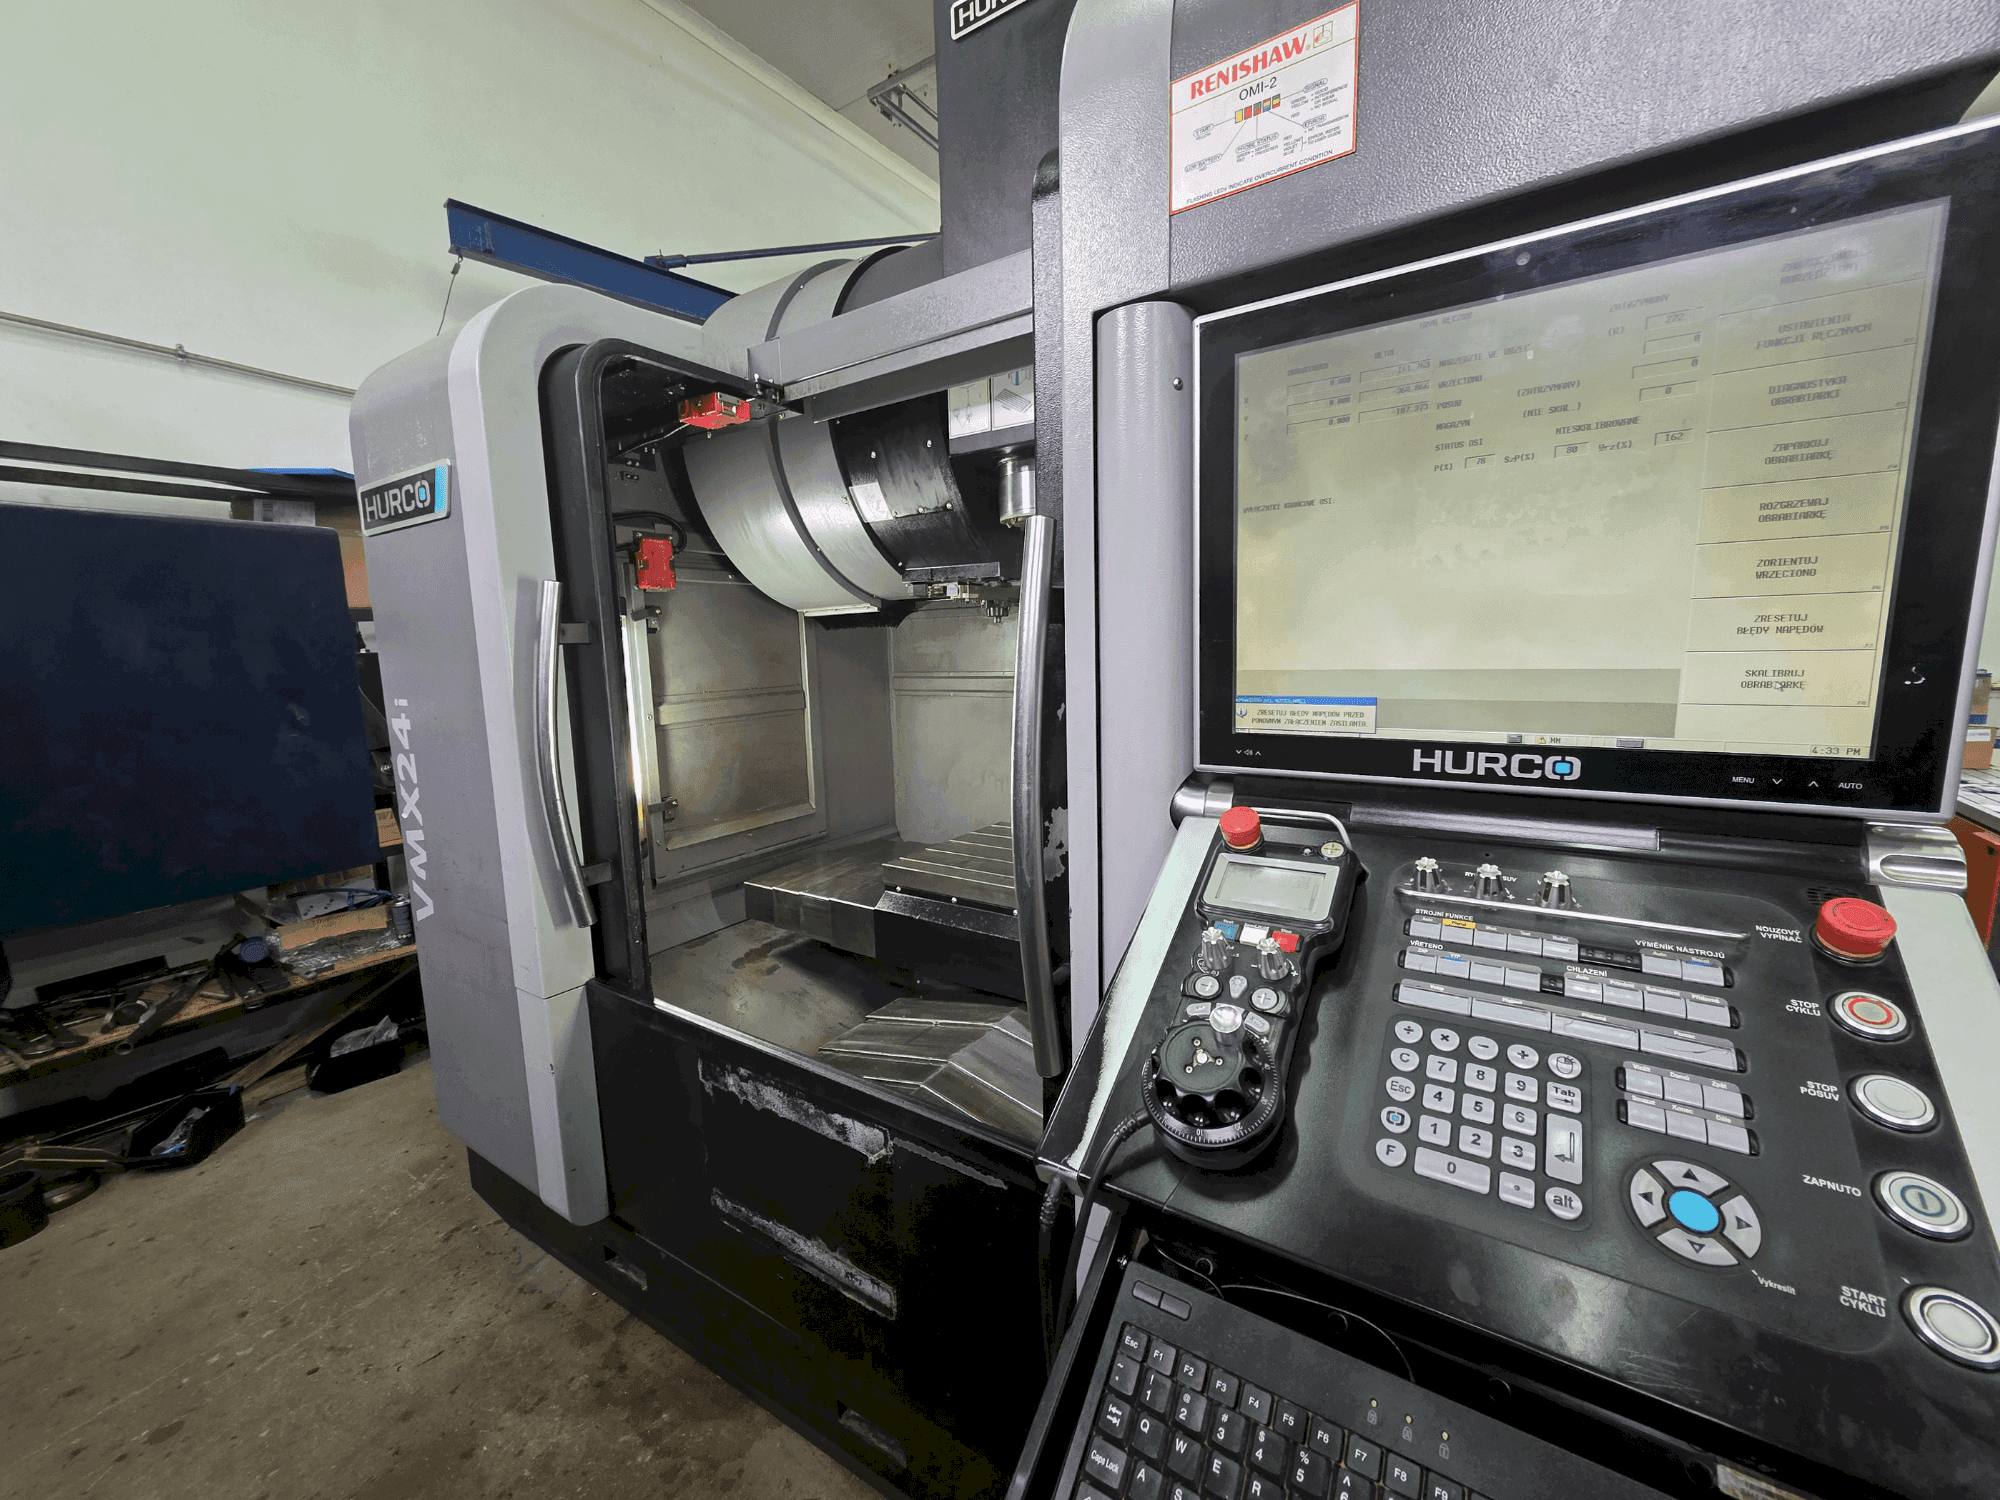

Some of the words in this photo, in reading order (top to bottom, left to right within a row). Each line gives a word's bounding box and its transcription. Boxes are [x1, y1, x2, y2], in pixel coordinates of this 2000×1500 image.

[1191, 33, 1307, 100] RENISHAW
[1239, 77, 1277, 101] OMI-2
[1187, 192, 1212, 204] FLASHING
[1228, 177, 1253, 189] INDICATE
[1299, 149, 1333, 165] CONDITION
[1665, 313, 1685, 324] 222
[1756, 333, 1805, 349] FUNKCJI
[1768, 376, 1847, 395] DIAGNOSTYKA
[1770, 388, 1841, 407] OBRABIARKI
[1436, 418, 1471, 431] MAGAZYN
[1665, 432, 1684, 442] 162
[1435, 440, 1465, 451] STATUS
[1468, 438, 1483, 447] OSI
[1772, 438, 1829, 452] ZAPARKUJ
[1764, 450, 1834, 465] OBRABIARKĘ
[1434, 462, 1453, 472] P(%)
[365, 479, 431, 522] HURCO
[1319, 497, 1336, 506] OSI:
[1759, 497, 1829, 511] ROZGRZEWAJ
[1758, 509, 1827, 523] OBRABIARKĘ
[1756, 556, 1819, 568] ZORIENTUJ
[1756, 568, 1817, 580] WRZECIONO
[1754, 613, 1808, 623] ZRESETUJ
[1736, 626, 1770, 636] BŁĘDY
[1775, 623, 1824, 635] NAPĘDÓW
[1745, 669, 1805, 678] SKALIBRUJ
[1256, 709, 1287, 717] ZRESETUJ
[1343, 711, 1365, 719] PRZED
[1812, 746, 1840, 755] 4:33
[1846, 747, 1862, 756] PM
[1412, 748, 1582, 781] HURCO
[1732, 776, 1755, 784] MENU
[1838, 782, 1863, 790] AUTO
[391, 698, 434, 921] VMX24i
[1415, 908, 1444, 917] STROJNÍ
[1445, 912, 1474, 922] FUNKCE
[1755, 924, 1801, 936] NOUZOVÝ
[1760, 931, 1803, 943] VYPÍNAČ
[1410, 939, 1444, 950] VŘETENO
[1634, 939, 1675, 951] VÝMĚNÍK
[1676, 944, 1726, 959] NÁSTROJŮ
[1566, 964, 1608, 978] CHLAZENÍ
[1575, 973, 1590, 981] Auto
[1785, 1004, 1821, 1017] CYKLU
[1790, 999, 1819, 1009] STOP
[1400, 1052, 1411, 1063] C
[1437, 1061, 1447, 1072] 7
[1475, 1069, 1486, 1081] 8
[1390, 1080, 1411, 1095] Esc
[1516, 1080, 1527, 1092] 9
[1552, 1086, 1576, 1098] Tab
[1806, 1080, 1838, 1093] STOP
[1433, 1091, 1444, 1102] 4
[1799, 1086, 1840, 1102] POSUV
[1473, 1101, 1484, 1113] 5
[1672, 1104, 1694, 1115] Konec
[1515, 1111, 1525, 1124] 6
[1430, 1123, 1438, 1135] 1
[1470, 1133, 1481, 1146] 2
[1385, 1144, 1396, 1156] F
[1513, 1145, 1524, 1158] 3
[1447, 1161, 1457, 1175] 0
[1802, 1174, 1862, 1197] ZAPNUTO
[1553, 1195, 1574, 1210] alt
[1757, 1276, 1797, 1296] Vykreslit
[1841, 1285, 1887, 1308] START
[1839, 1295, 1886, 1318] CYKLU
[1124, 1335, 1139, 1349] Esc
[1153, 1350, 1164, 1361] F1
[1183, 1364, 1195, 1377] F2
[1215, 1380, 1227, 1393] F3
[1146, 1389, 1152, 1401] 1
[1248, 1396, 1260, 1409] F4
[1179, 1408, 1188, 1421] 2
[1282, 1413, 1295, 1426] F5
[1140, 1418, 1150, 1434] Q
[1216, 1427, 1225, 1440] 3
[1317, 1430, 1330, 1444] F6
[1175, 1437, 1188, 1454] W
[1255, 1448, 1263, 1461] 4
[1354, 1448, 1368, 1462] F7
[1090, 1449, 1106, 1468] Caps
[1105, 1460, 1119, 1475] Lock
[1212, 1458, 1222, 1474] E
[1136, 1467, 1146, 1482] A
[1296, 1468, 1305, 1482] 5
[1394, 1467, 1407, 1482] F8
[1174, 1488, 1183, 1500] S
[1251, 1480, 1262, 1497] R
[1434, 1486, 1449, 1500] F9
